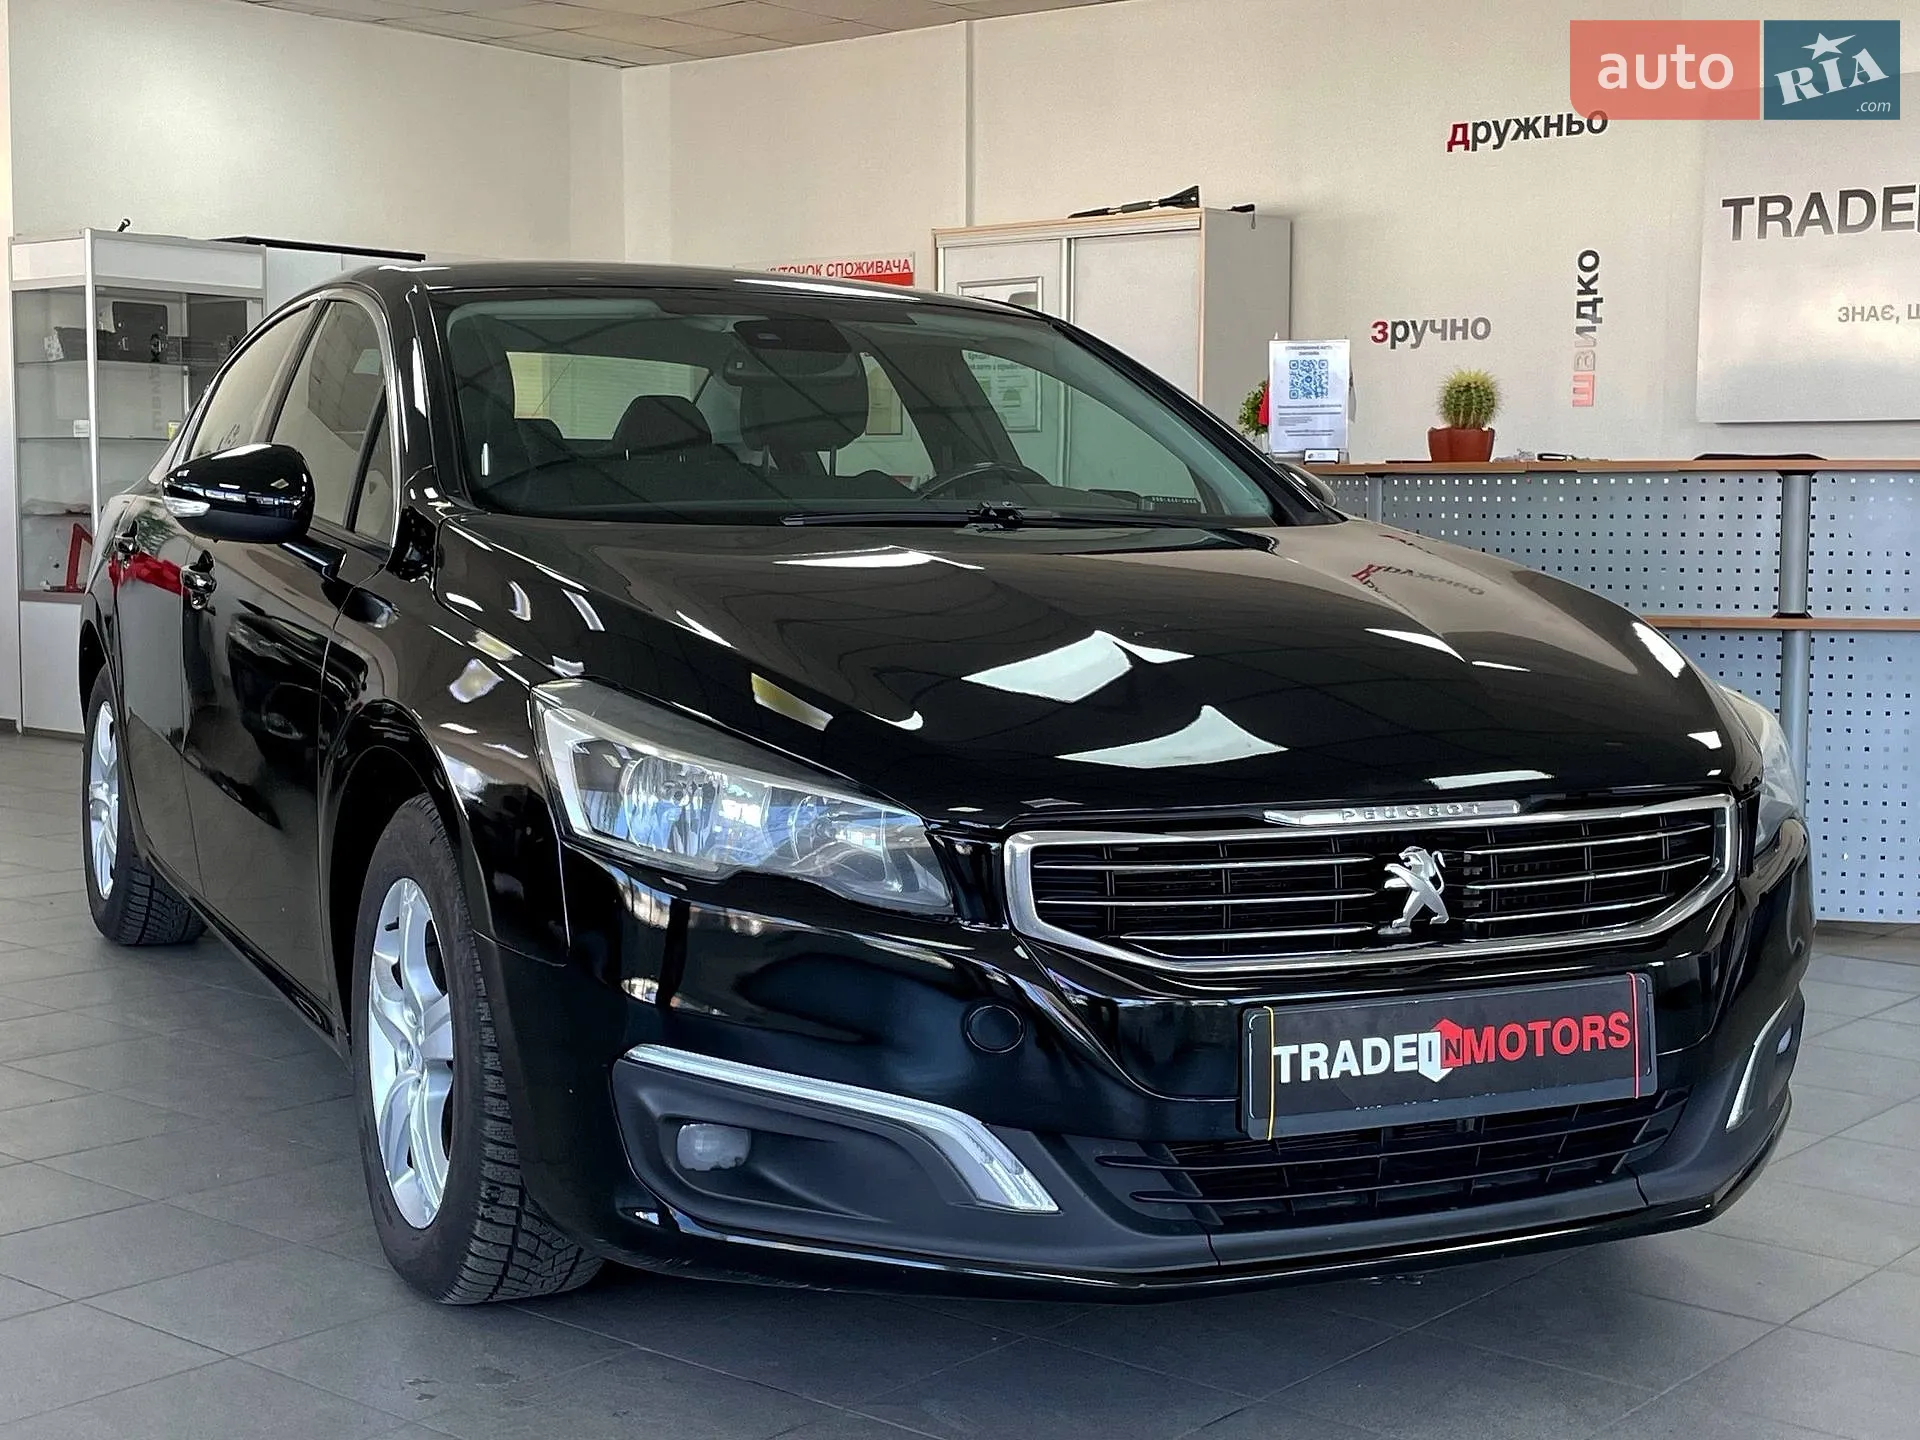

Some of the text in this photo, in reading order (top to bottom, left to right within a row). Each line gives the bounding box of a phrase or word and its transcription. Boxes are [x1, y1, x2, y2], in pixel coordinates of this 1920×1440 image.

[1446, 109, 1609, 153] дружньо
[766, 258, 912, 277] ТОЧОК СПОЖИВАЧА
[1370, 316, 1492, 350] зручно
[1571, 249, 1604, 408] швидко
[1340, 802, 1481, 821] PEUGEOT
